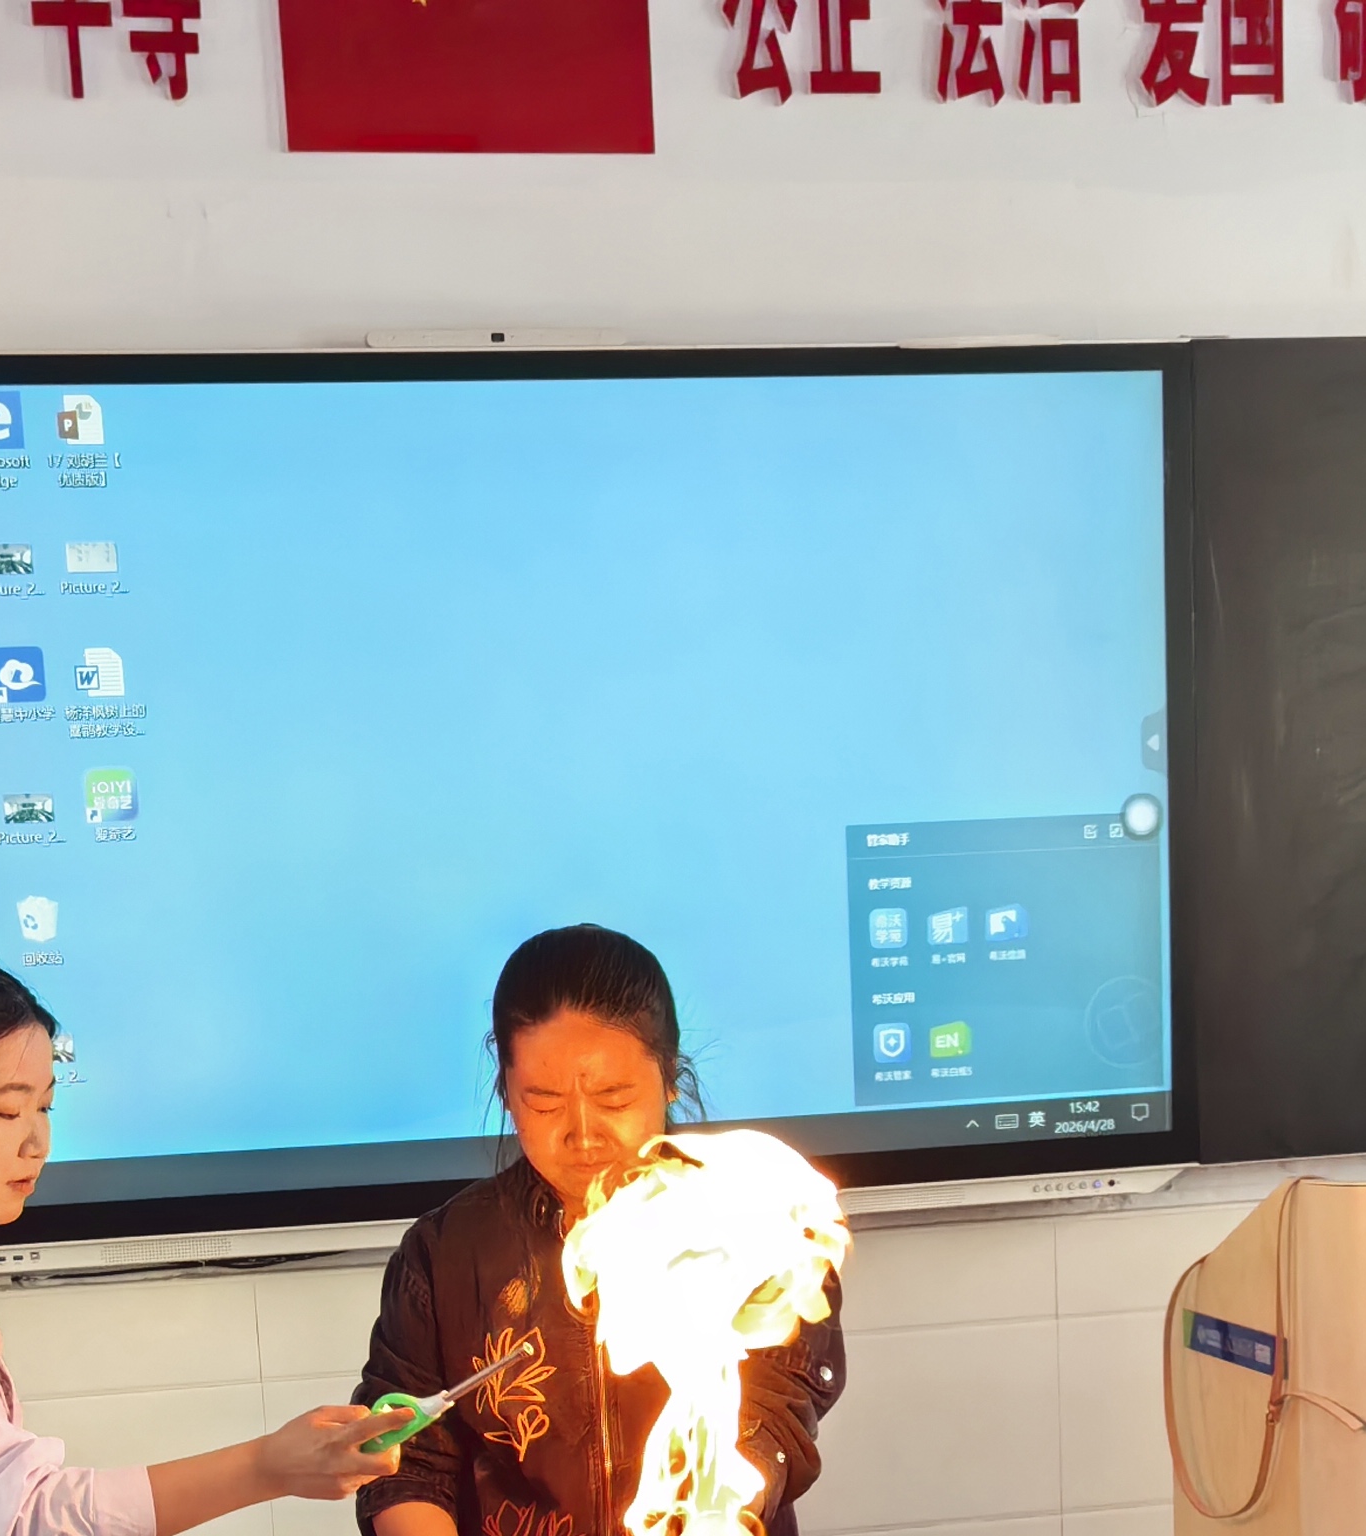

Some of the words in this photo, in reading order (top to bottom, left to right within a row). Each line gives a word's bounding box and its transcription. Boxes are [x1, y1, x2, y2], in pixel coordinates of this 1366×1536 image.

[47, 455, 63, 468] 17
[92, 780, 132, 794] iQIYI
[23, 953, 64, 968] 回收站
[935, 1031, 960, 1049] EN
[1069, 1100, 1100, 1114] 15:42
[1028, 1111, 1046, 1128] 英
[1054, 1118, 1116, 1134] 2026/4/28
